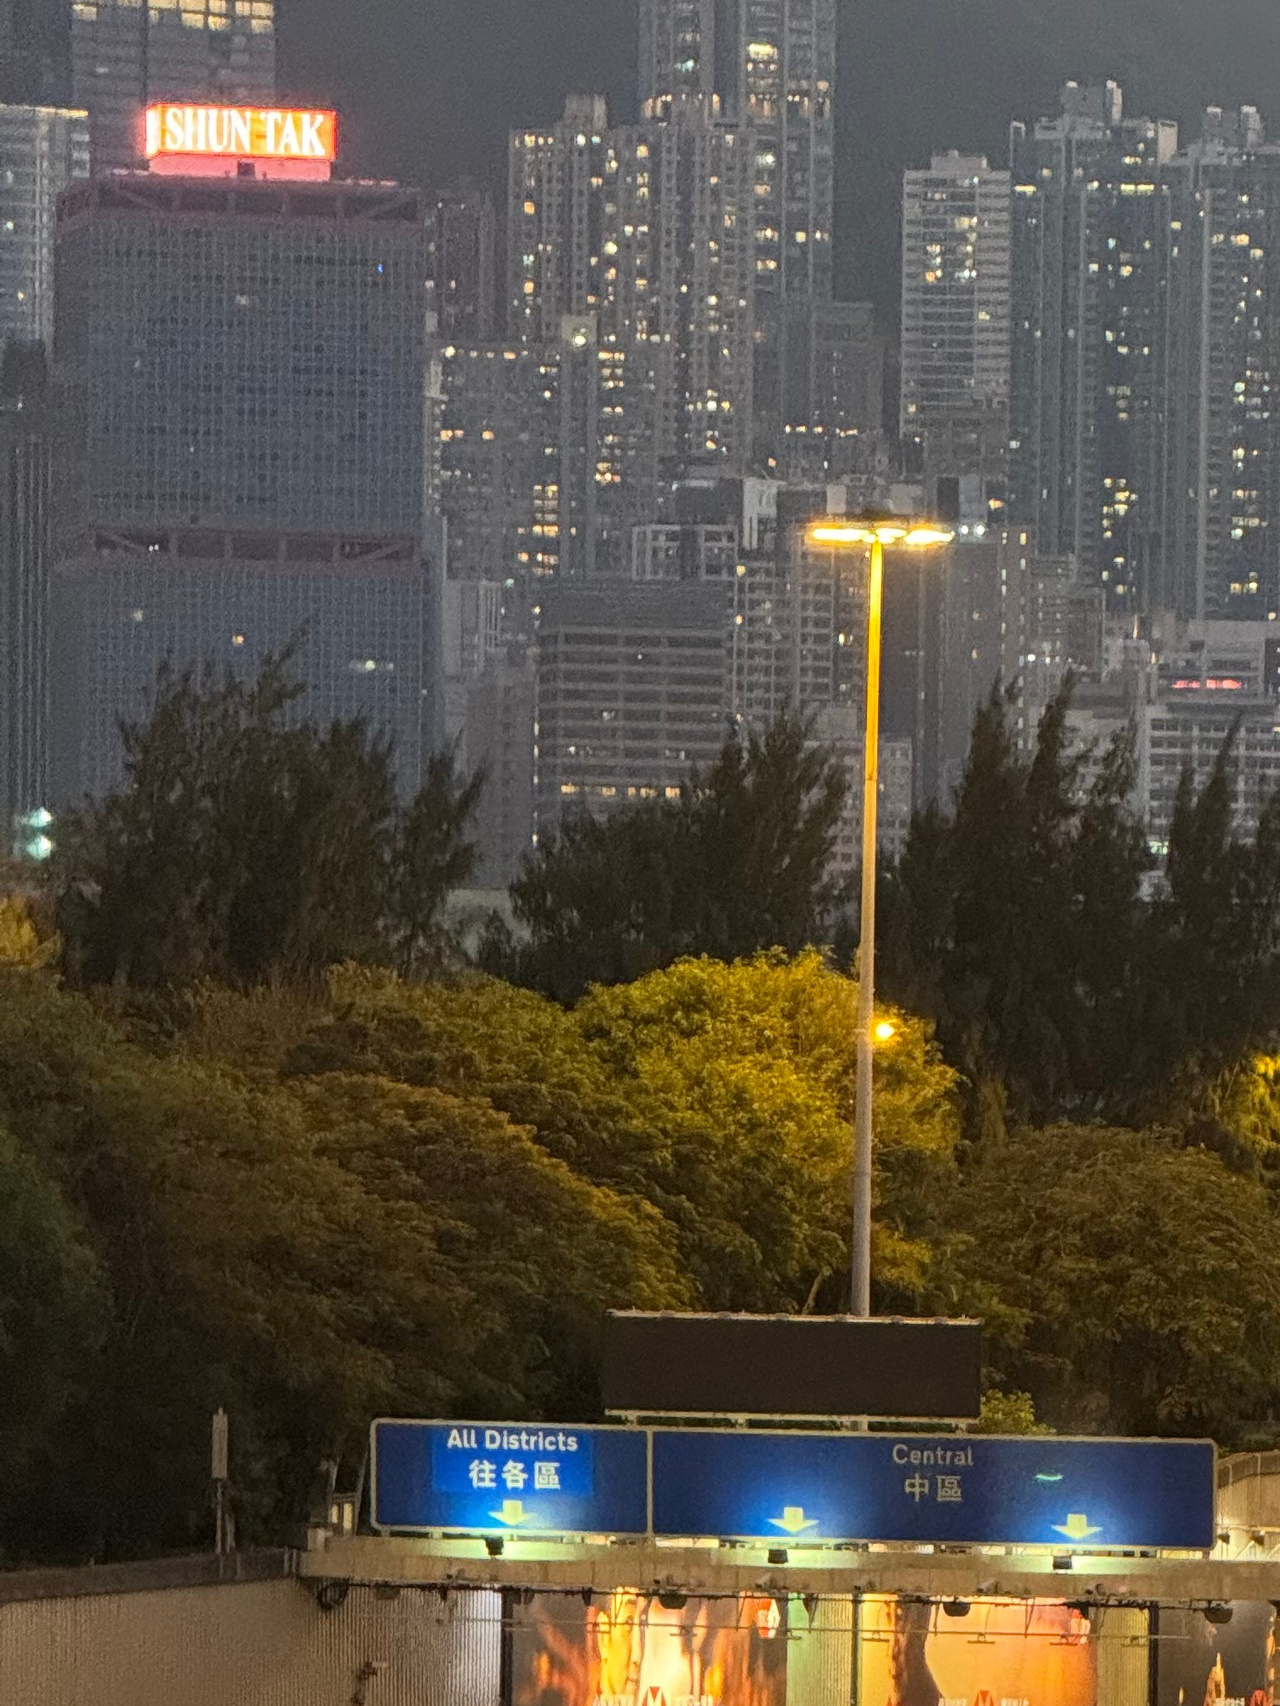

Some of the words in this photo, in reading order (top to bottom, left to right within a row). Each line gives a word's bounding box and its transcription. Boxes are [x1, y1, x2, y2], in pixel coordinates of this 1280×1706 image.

[165, 107, 250, 154] SHUN
[260, 111, 326, 156] TAK
[446, 1429, 478, 1449] All
[484, 1430, 579, 1452] Districts
[892, 1443, 975, 1467] Central
[468, 1459, 561, 1490] 往各區
[904, 1472, 963, 1502] 中區
